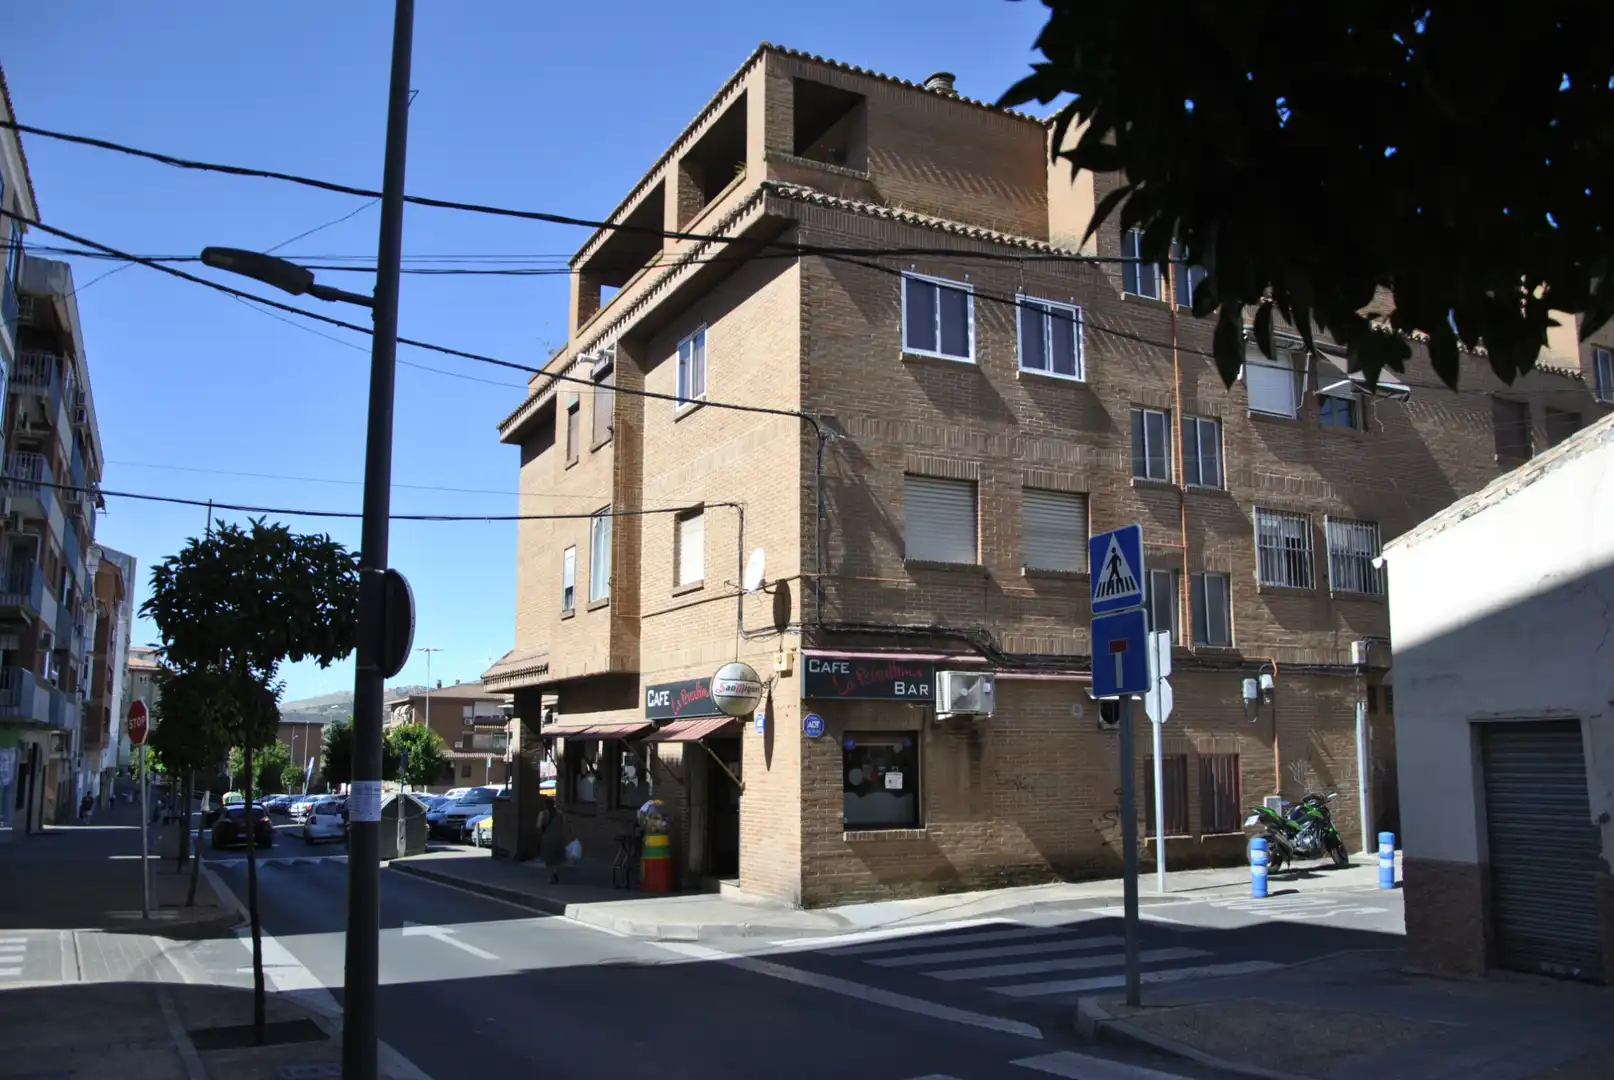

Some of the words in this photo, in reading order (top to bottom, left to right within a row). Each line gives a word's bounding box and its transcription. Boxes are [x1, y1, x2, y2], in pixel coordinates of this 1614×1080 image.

[809, 659, 850, 674] CAFE
[894, 681, 929, 695] BAR
[647, 689, 670, 707] CAFE
[128, 715, 146, 730] STOP
